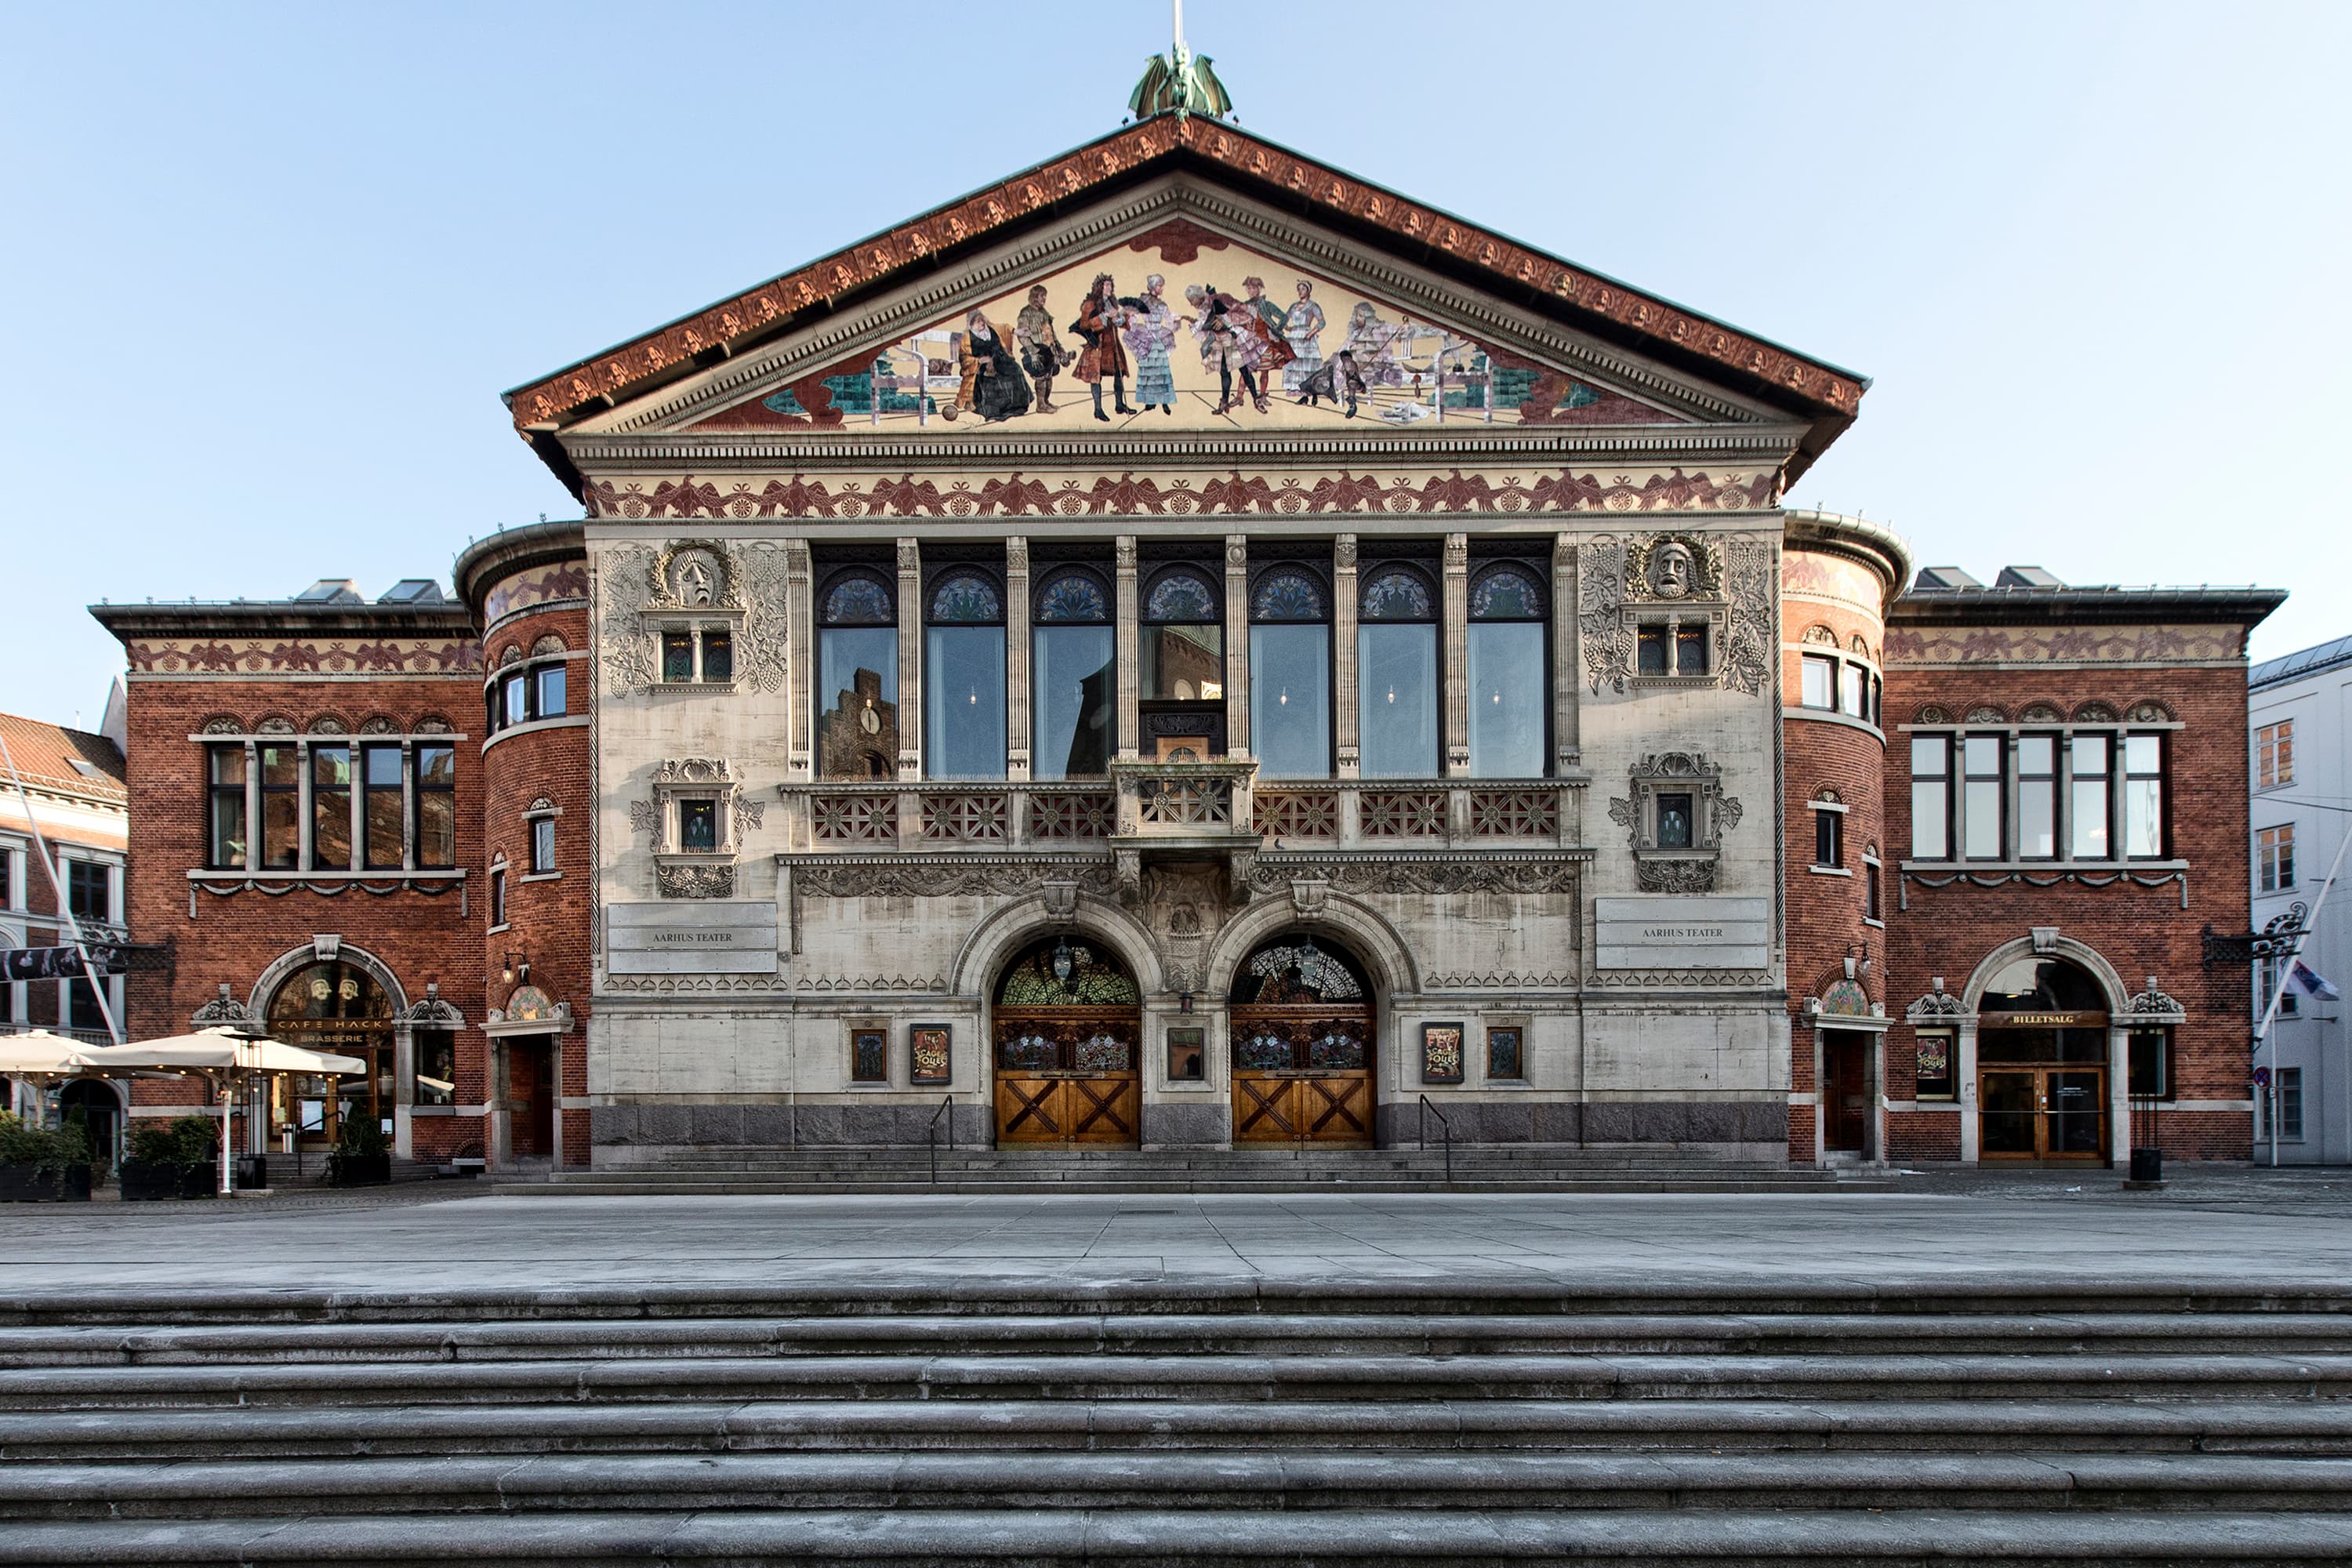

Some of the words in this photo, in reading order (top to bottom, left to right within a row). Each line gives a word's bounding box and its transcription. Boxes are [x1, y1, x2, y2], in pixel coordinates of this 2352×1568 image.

[653, 933, 694, 942] AARHUS
[695, 933, 733, 942] TEATER
[1642, 928, 1684, 938] AARHUS
[1685, 928, 1723, 938] TEATER
[2013, 1014, 2074, 1024] BILLETSALG
[278, 1020, 324, 1029] CAFE
[335, 1020, 383, 1029] HACK
[300, 1034, 363, 1044] BRASSERIE
